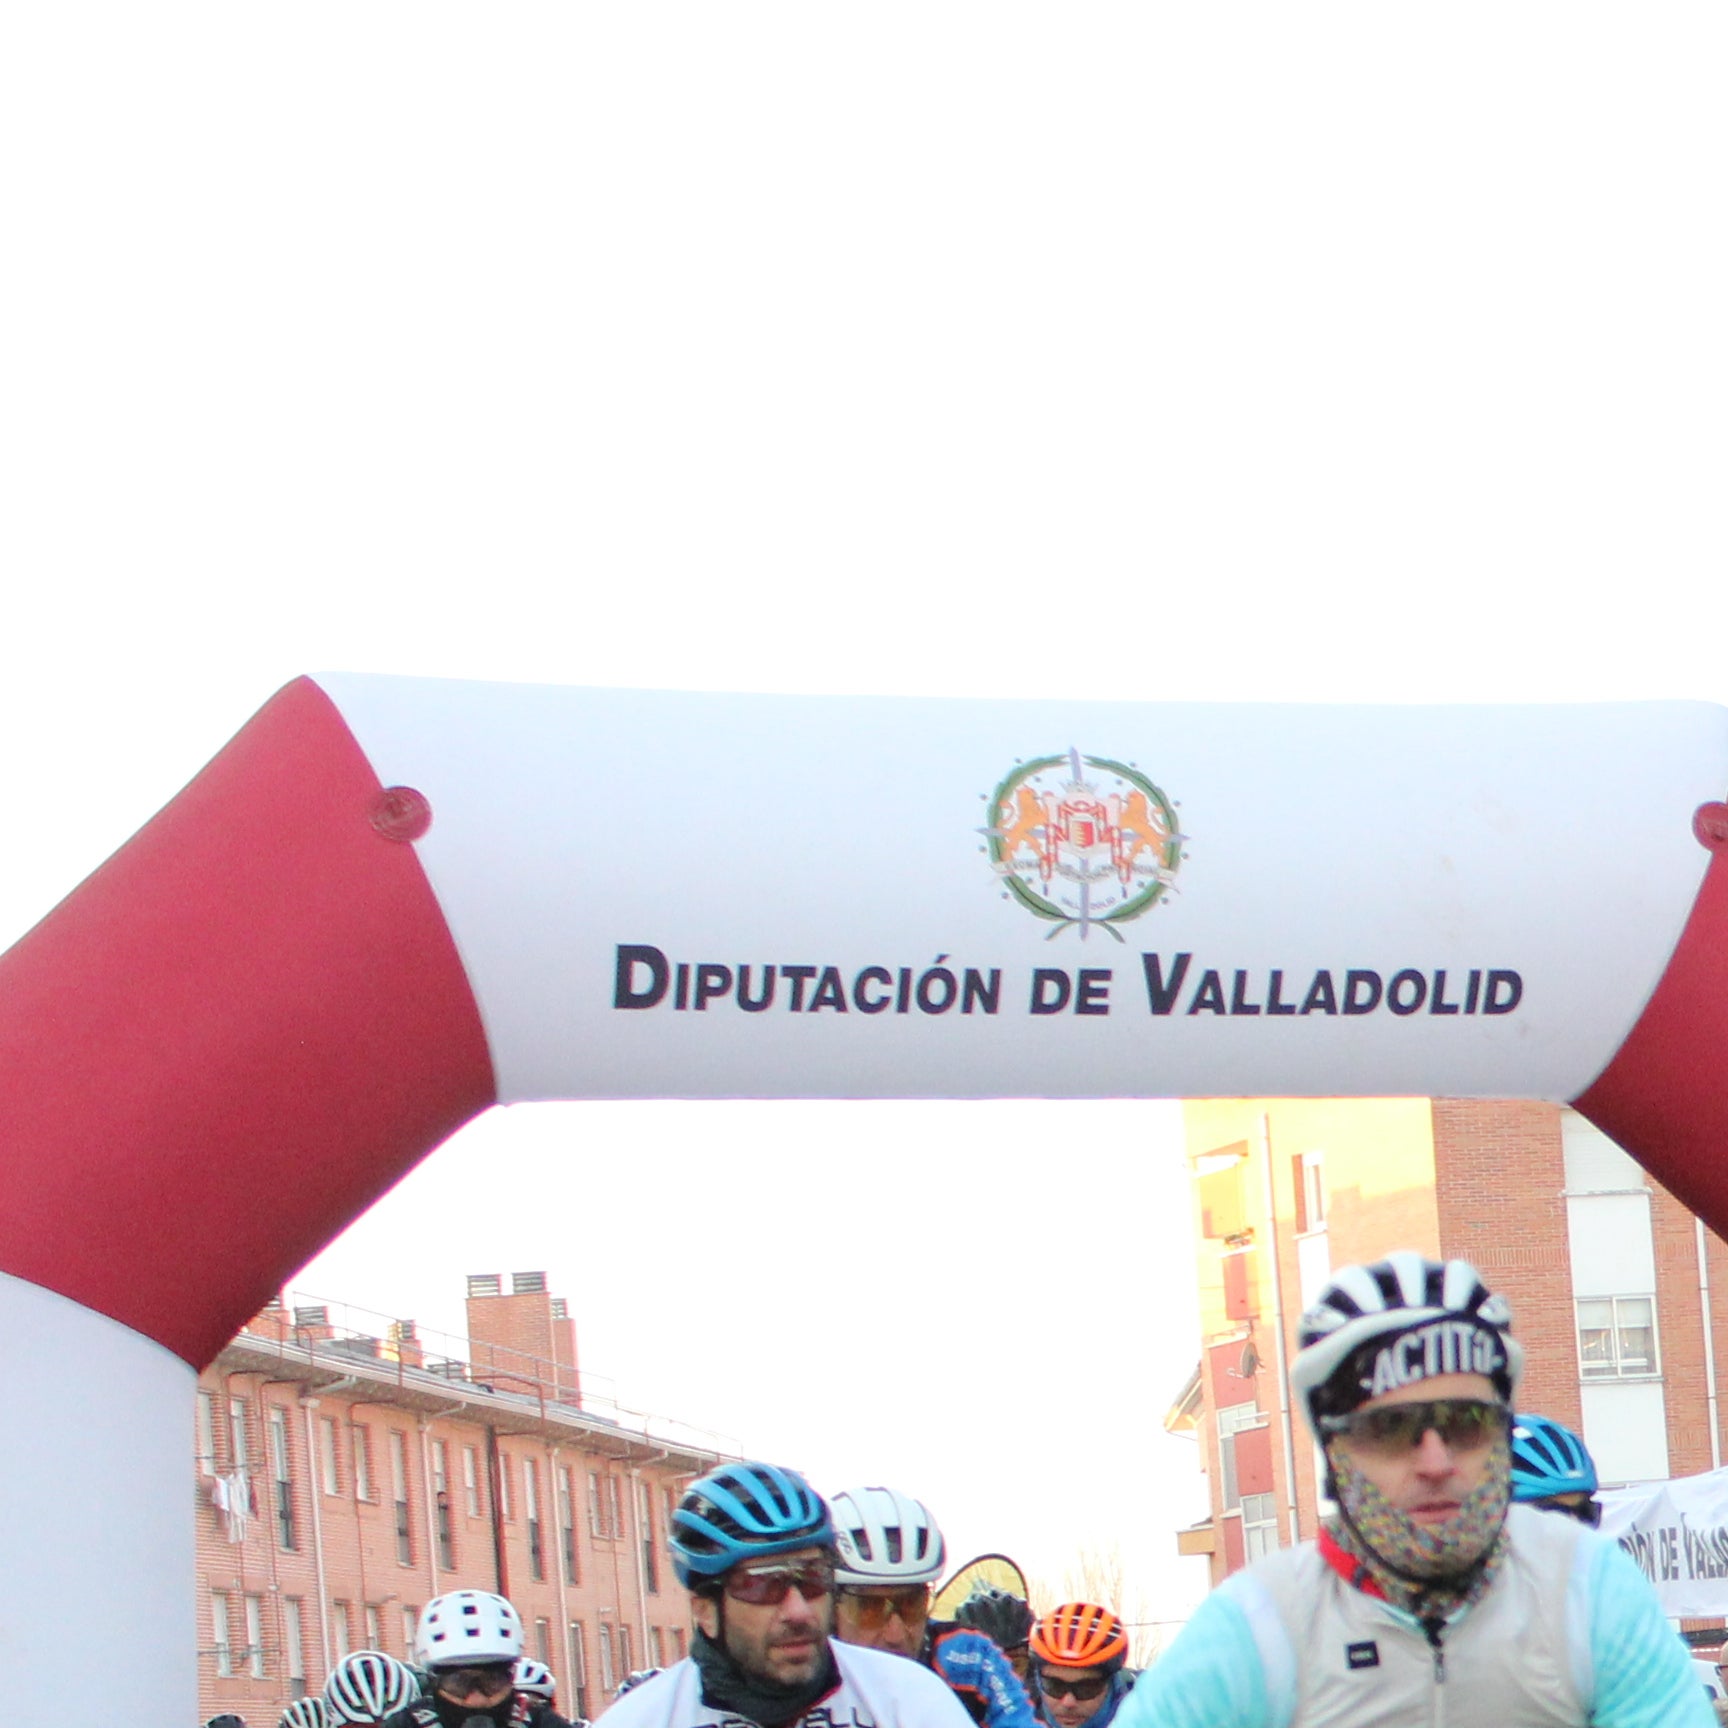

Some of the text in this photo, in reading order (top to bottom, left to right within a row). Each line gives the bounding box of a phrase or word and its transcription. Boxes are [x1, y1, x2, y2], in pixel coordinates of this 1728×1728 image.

[612, 943, 1523, 1016] DIPUTACIÓN DE VALLADOLID
